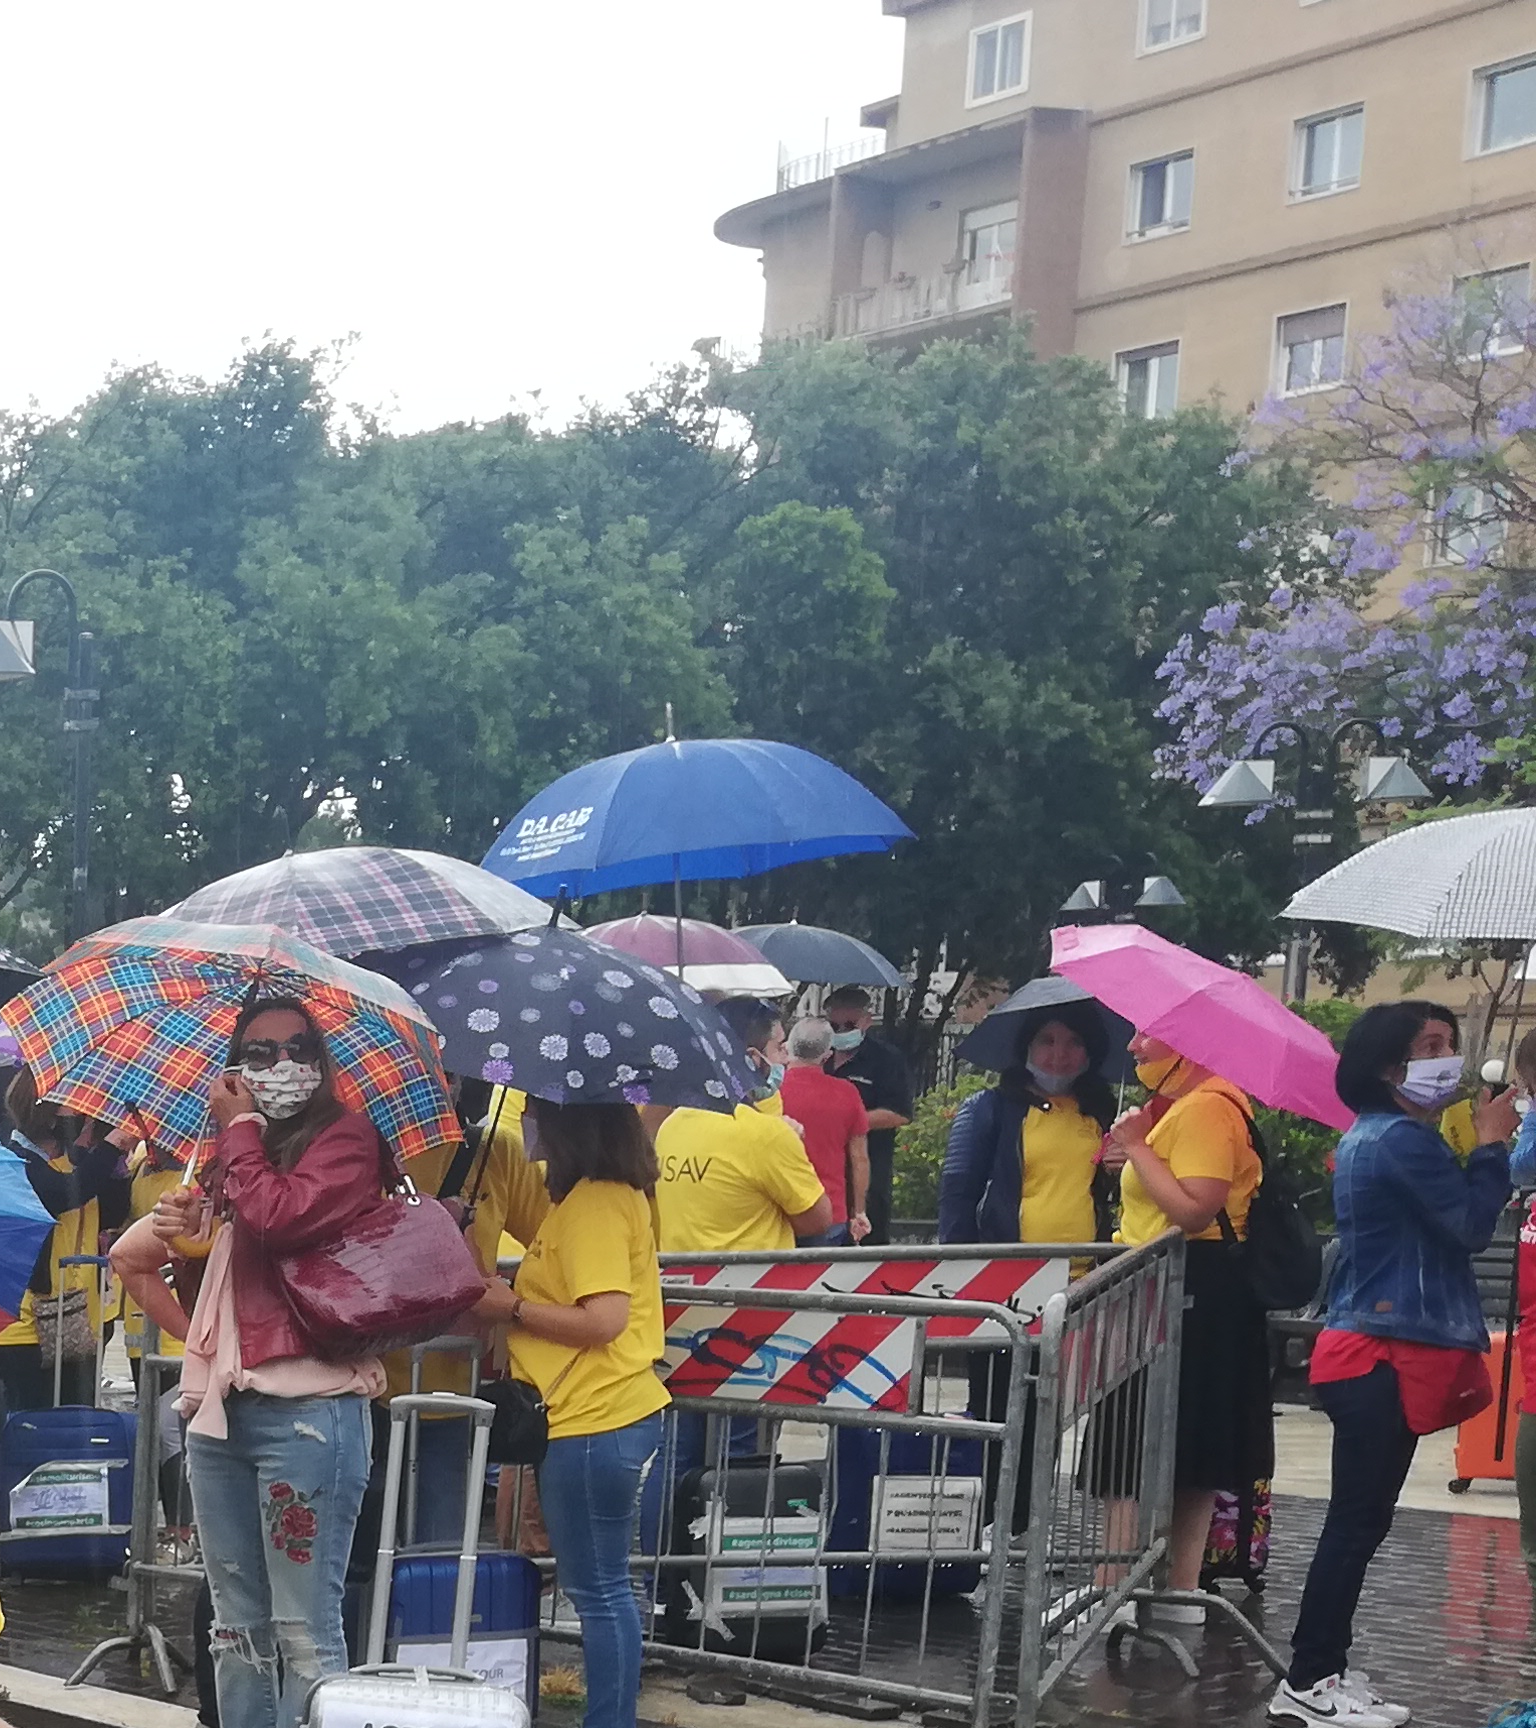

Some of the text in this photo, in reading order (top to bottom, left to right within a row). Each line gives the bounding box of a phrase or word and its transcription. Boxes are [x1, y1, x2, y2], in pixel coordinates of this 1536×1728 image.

[659, 1154, 712, 1183] ISAV
[731, 1537, 814, 1549] #agendiviaggi
[729, 1590, 782, 1600] #sardgna
[473, 1668, 504, 1682] OUR
